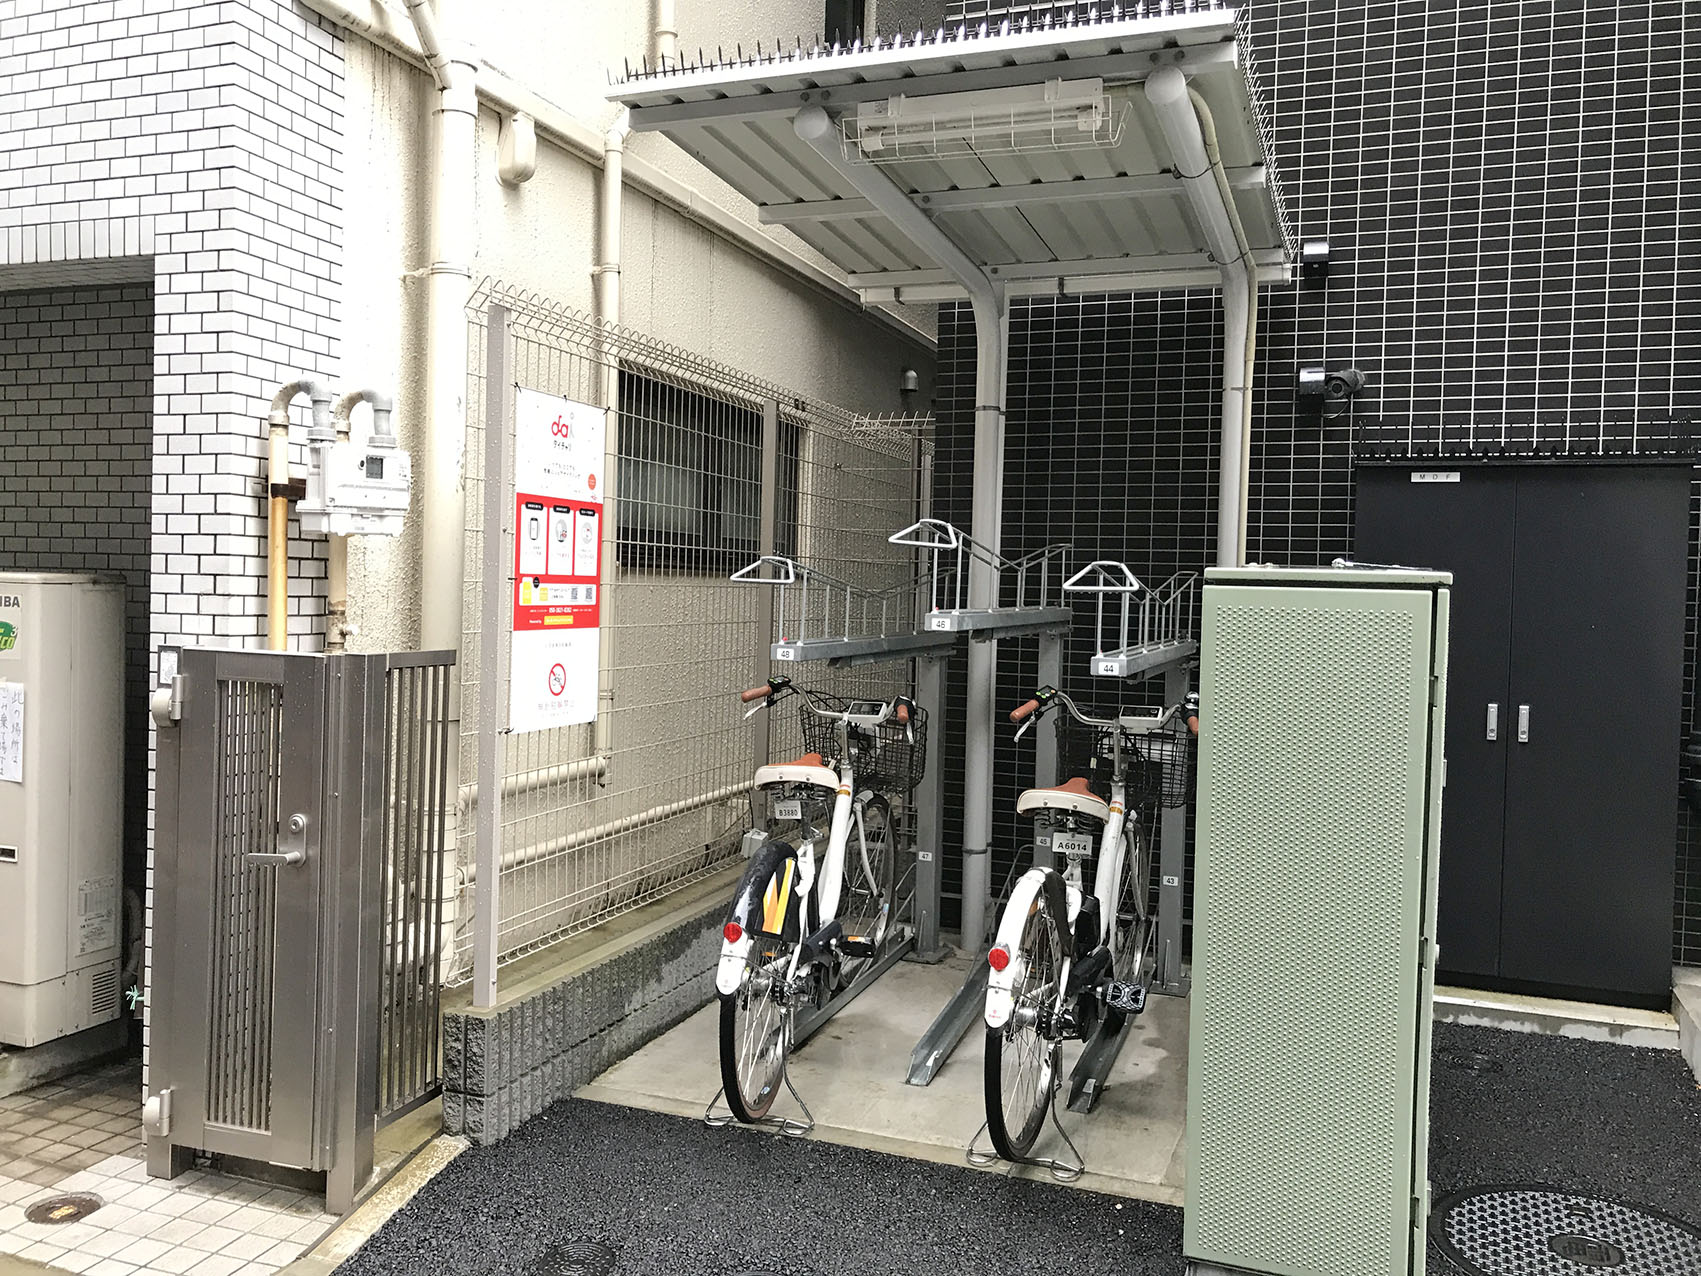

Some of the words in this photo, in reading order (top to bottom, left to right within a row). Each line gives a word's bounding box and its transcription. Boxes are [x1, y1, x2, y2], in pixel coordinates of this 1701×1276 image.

[935, 620, 946, 629] 46
[780, 650, 790, 659] 48
[1103, 664, 1114, 673] 44
[1039, 838, 1048, 846] 45
[1057, 841, 1087, 852] A6014
[1166, 877, 1175, 885] 43
